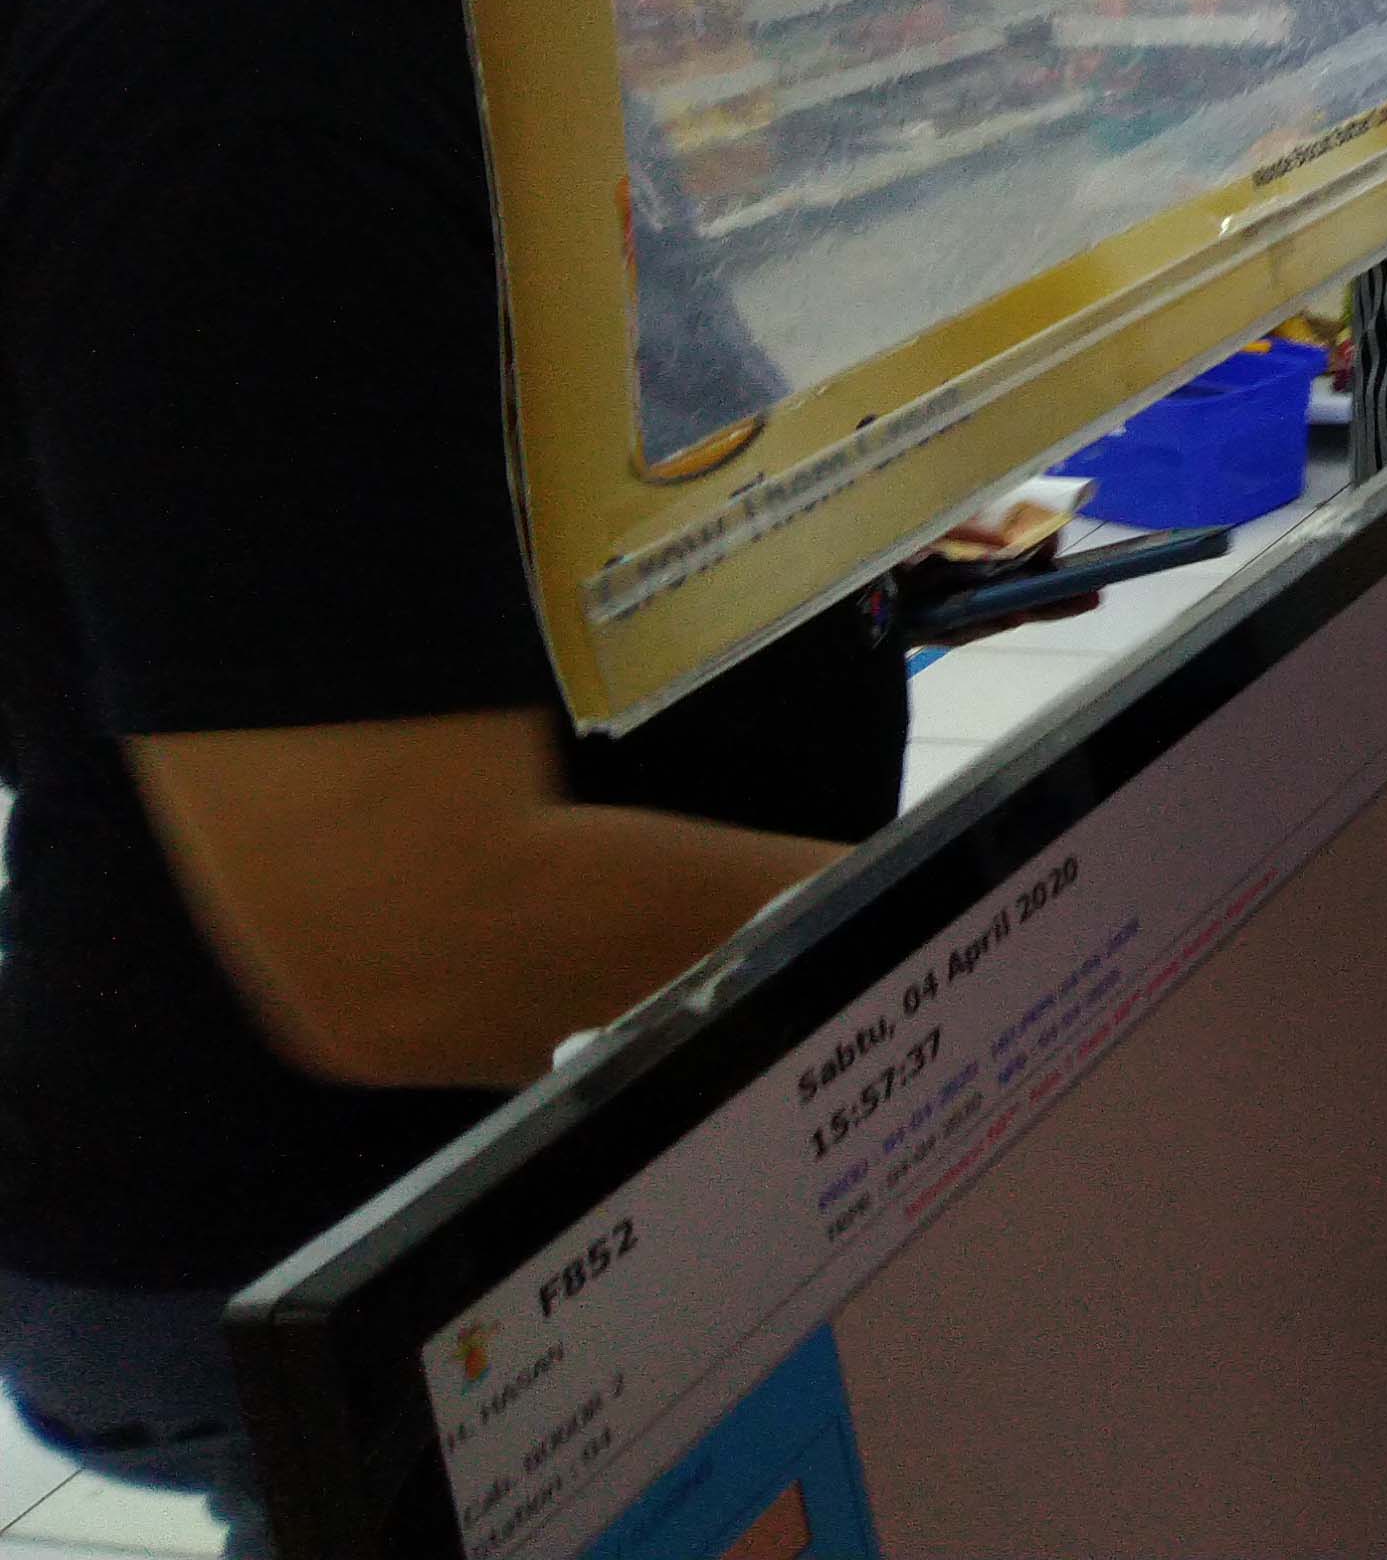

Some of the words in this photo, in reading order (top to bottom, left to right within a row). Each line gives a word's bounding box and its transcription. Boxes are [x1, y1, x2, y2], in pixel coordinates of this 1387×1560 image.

[798, 1017, 896, 1105] Sabtu,
[903, 971, 940, 1016] 04
[946, 910, 1011, 984] April
[1016, 856, 1080, 926] 2020
[809, 1025, 942, 1161] 15:57:37
